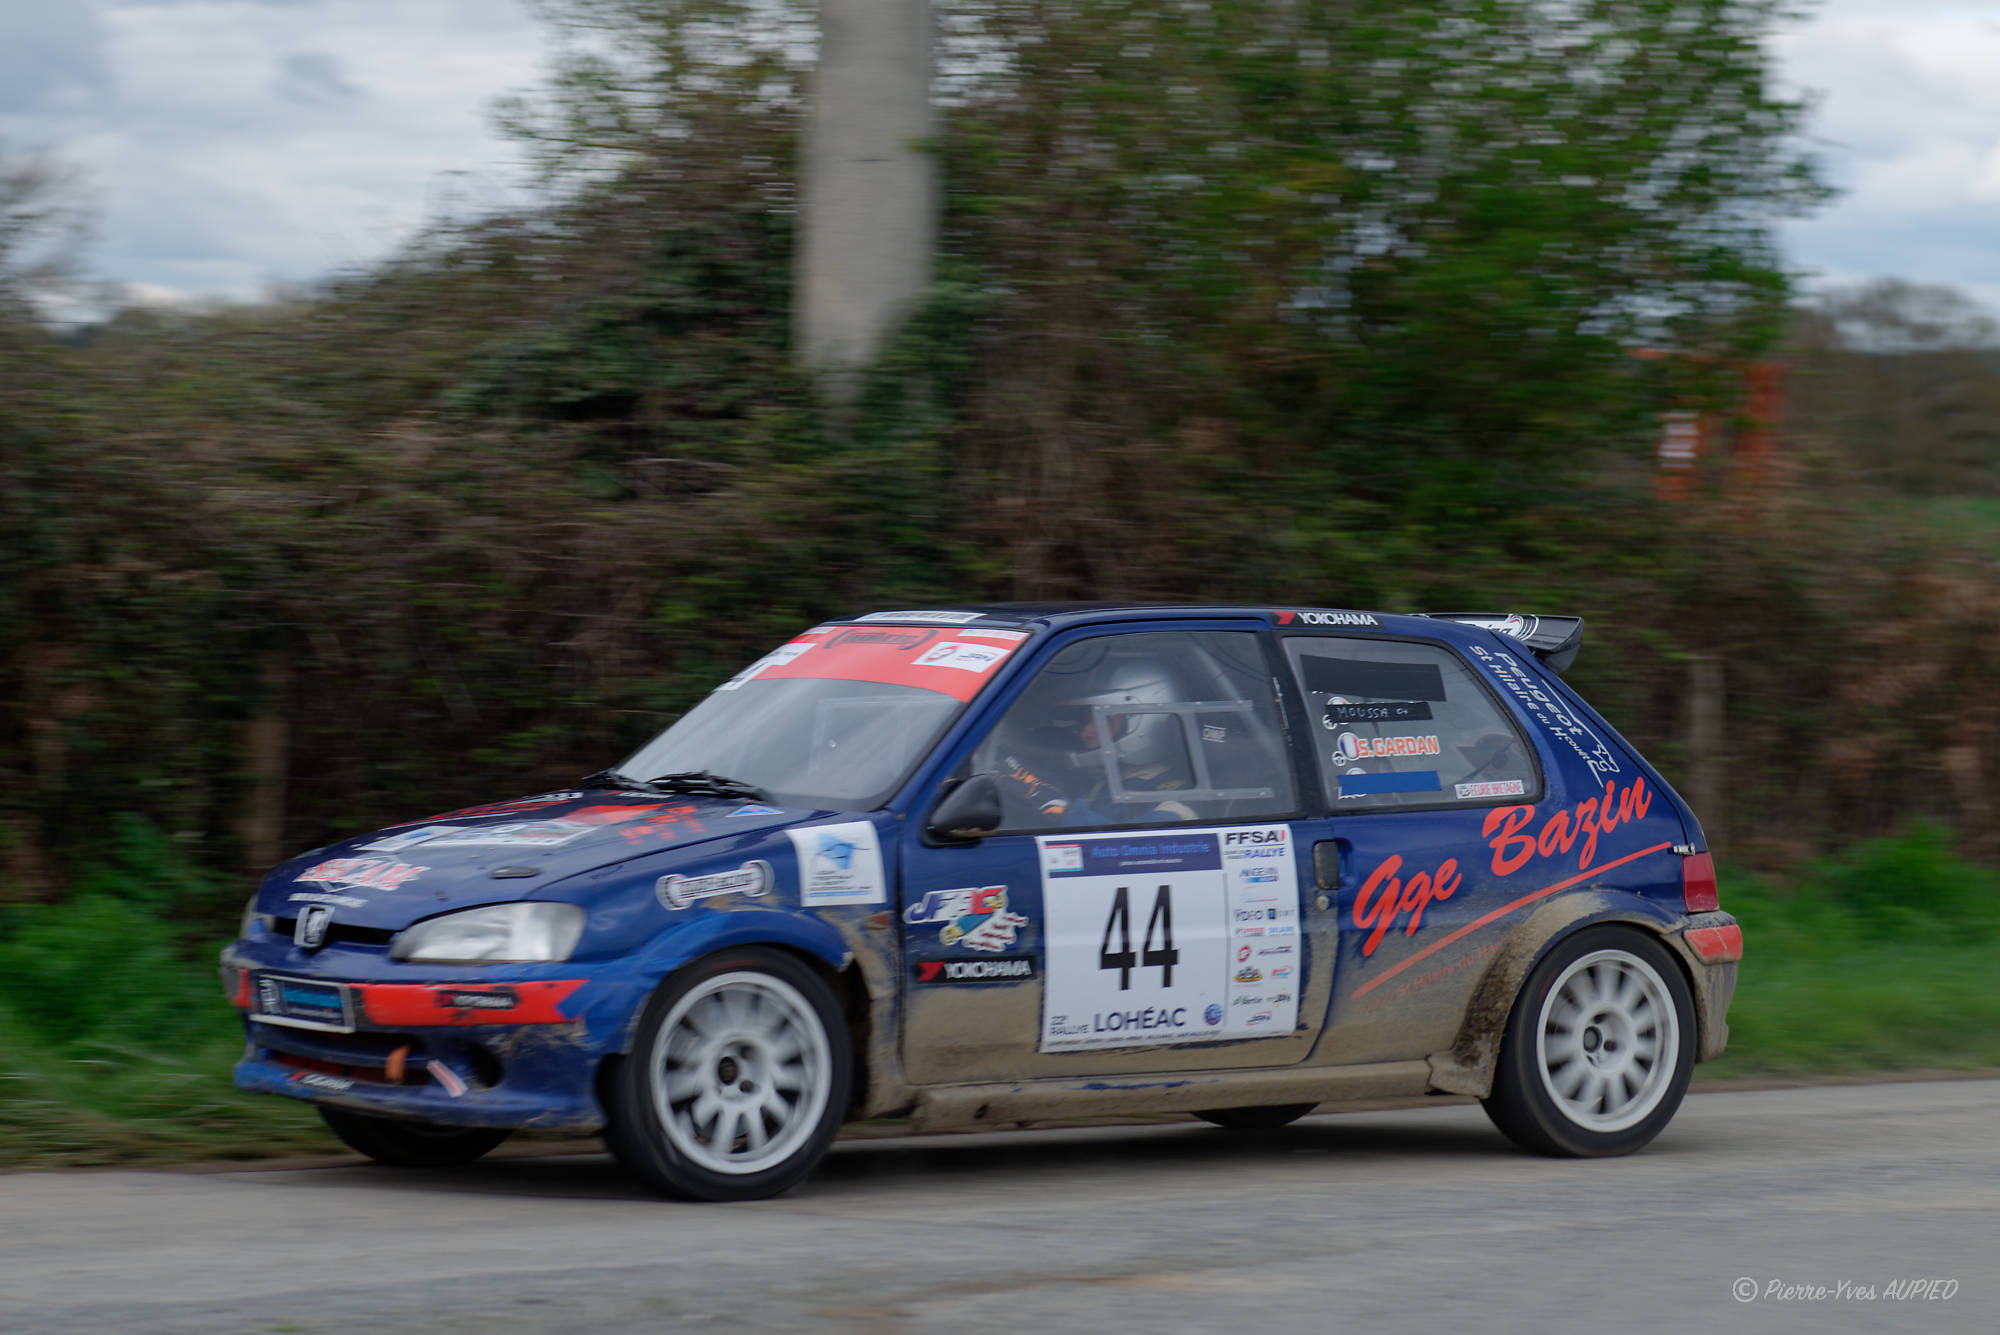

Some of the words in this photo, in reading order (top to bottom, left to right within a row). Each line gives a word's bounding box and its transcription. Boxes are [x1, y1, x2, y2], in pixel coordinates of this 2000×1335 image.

[1297, 611, 1378, 626] YOKOHAMA
[1469, 645, 1493, 661] St
[1488, 664, 1540, 710] Hilaire
[1536, 713, 1550, 724] du
[1494, 652, 1582, 735] Peugeot
[1336, 706, 1389, 719] MOUSSA
[1358, 736, 1440, 757] S.GARDAN
[1226, 830, 1281, 845] FFSA
[1482, 777, 1652, 877] Bazin
[1244, 847, 1286, 858] RALLYE
[1100, 885, 1179, 990] 44
[1093, 1006, 1187, 1033] LOHÉAC
